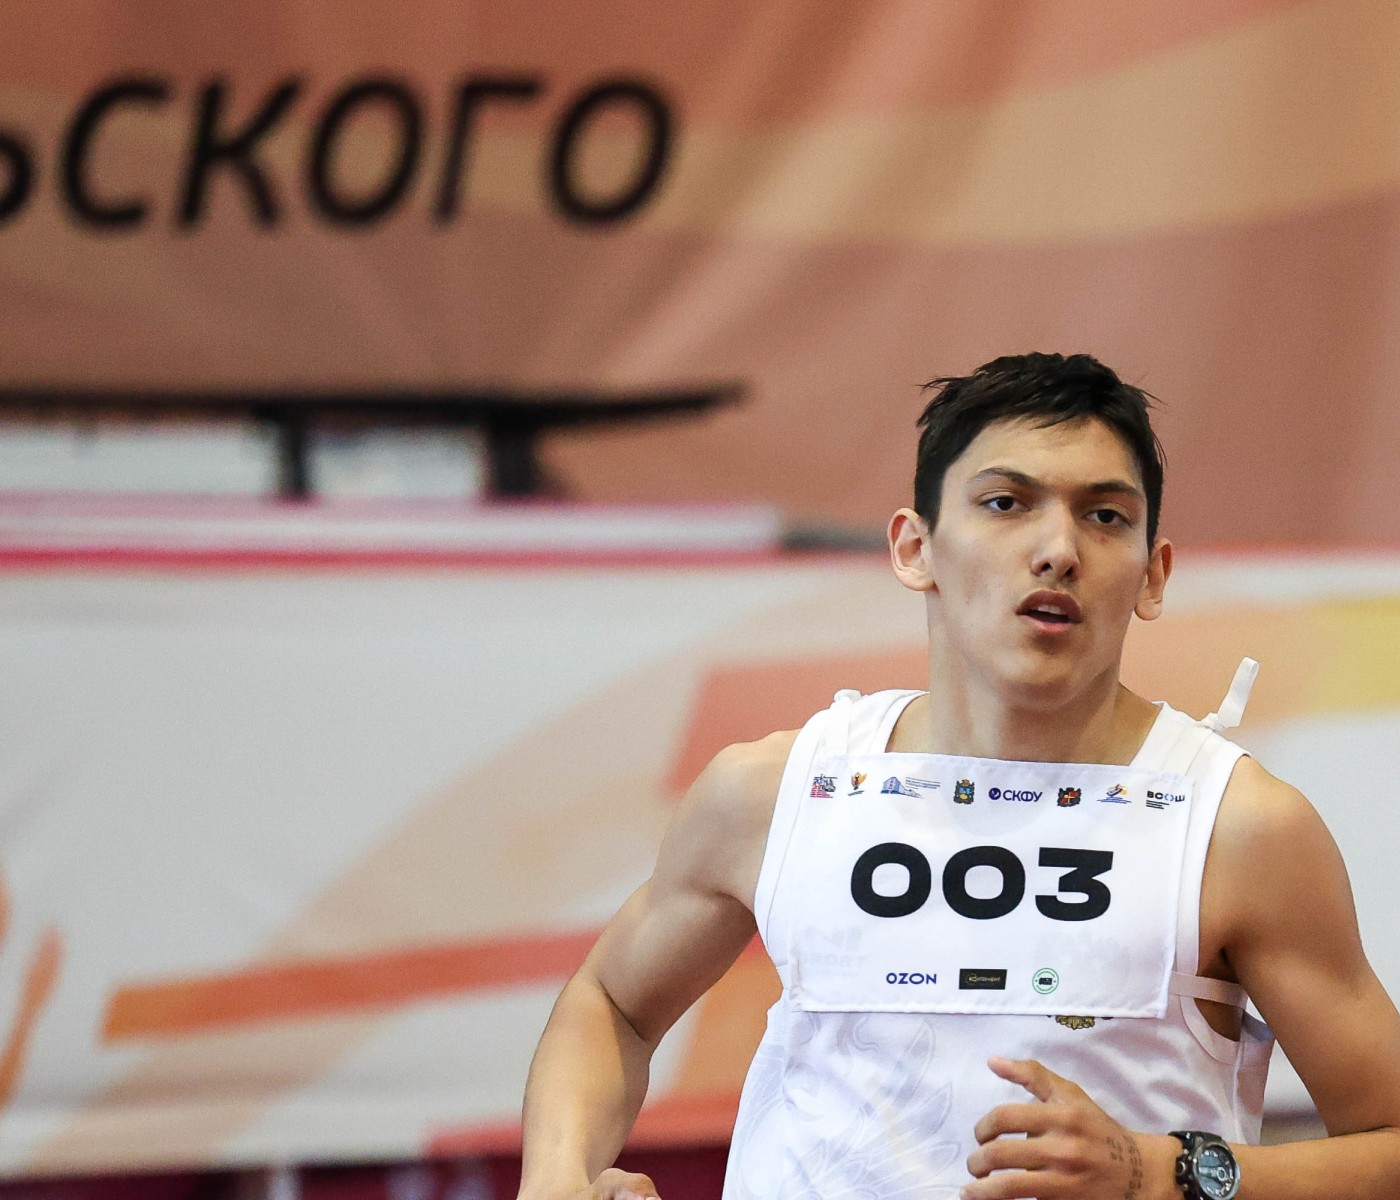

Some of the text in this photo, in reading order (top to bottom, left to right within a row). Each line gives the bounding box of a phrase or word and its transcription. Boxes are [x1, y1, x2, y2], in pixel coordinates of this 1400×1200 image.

[1003, 789, 1043, 802] СКФУ
[850, 841, 1114, 922] 003
[886, 972, 937, 985] OZON
